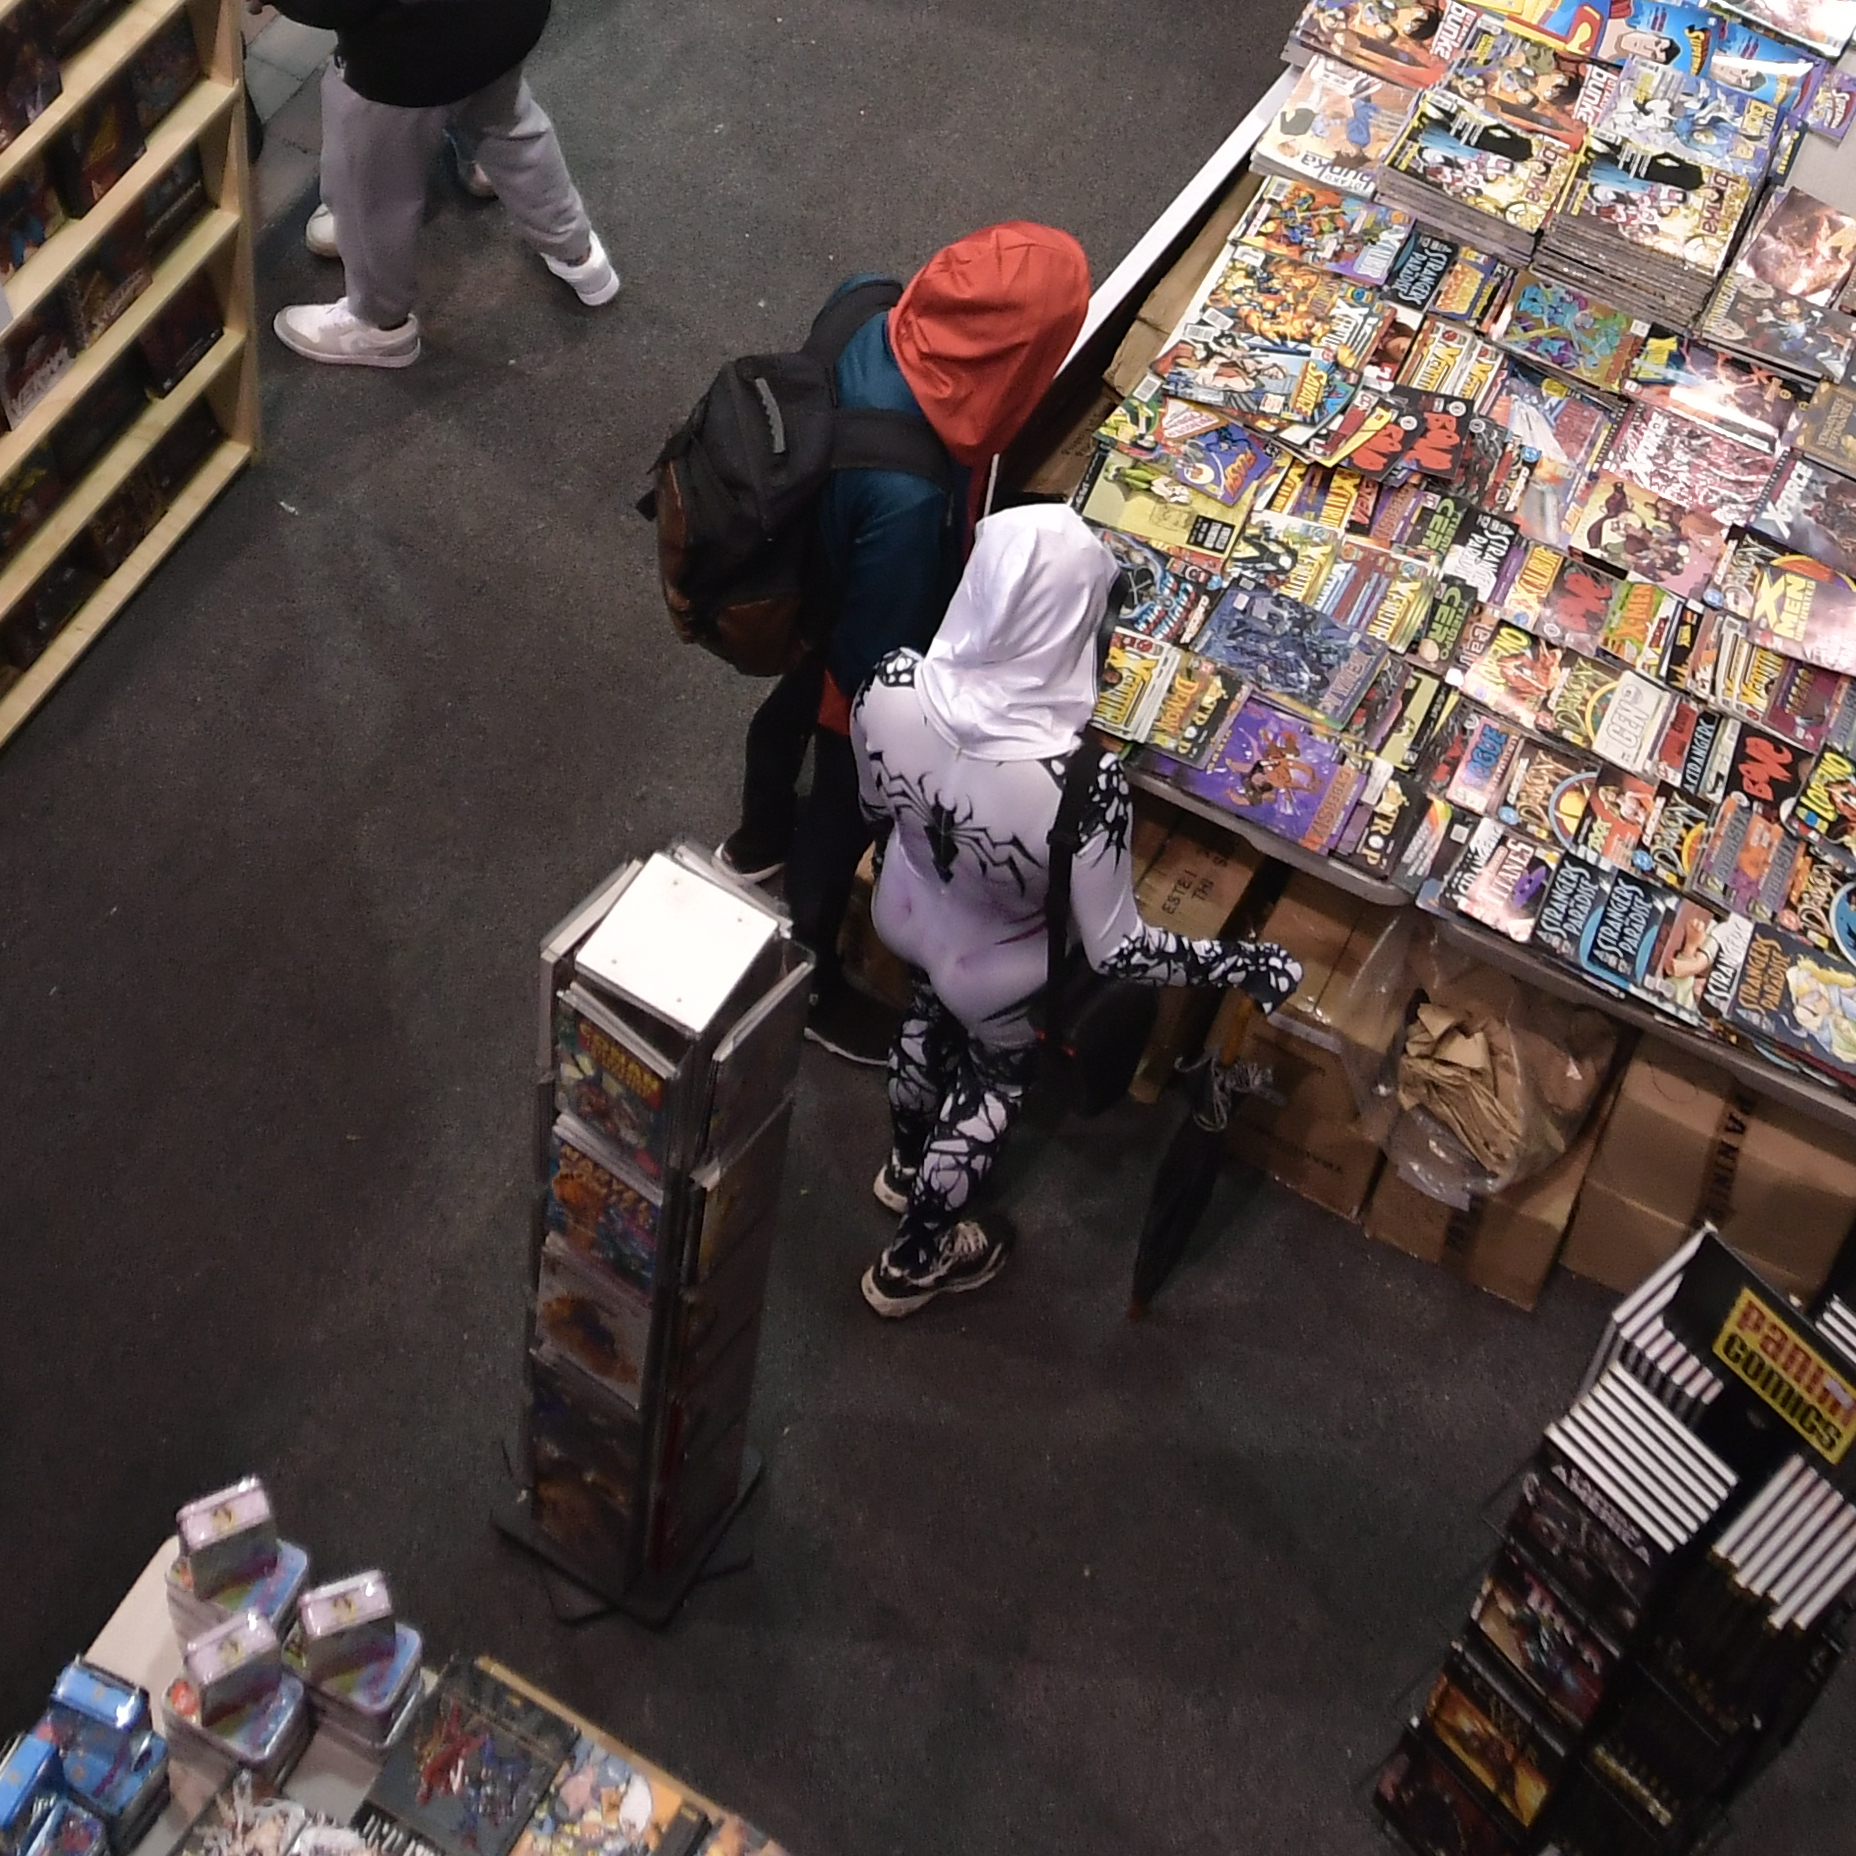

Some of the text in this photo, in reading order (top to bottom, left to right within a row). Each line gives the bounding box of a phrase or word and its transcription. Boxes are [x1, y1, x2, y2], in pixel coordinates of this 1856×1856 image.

[1300, 149, 1377, 189] bunka
[1406, 247, 1448, 306] STRANGERS
[1773, 574, 1808, 640] MEN
[1541, 858, 1591, 938] STRANGERS
[1563, 872, 1600, 936] PARADISE
[1598, 876, 1644, 959] STRANGERS
[1619, 885, 1653, 957] PARADISE
[1738, 934, 1785, 1014] STRANGERS
[1760, 946, 1793, 1013] PARADISE
[1722, 1332, 1844, 1452] COMICS
